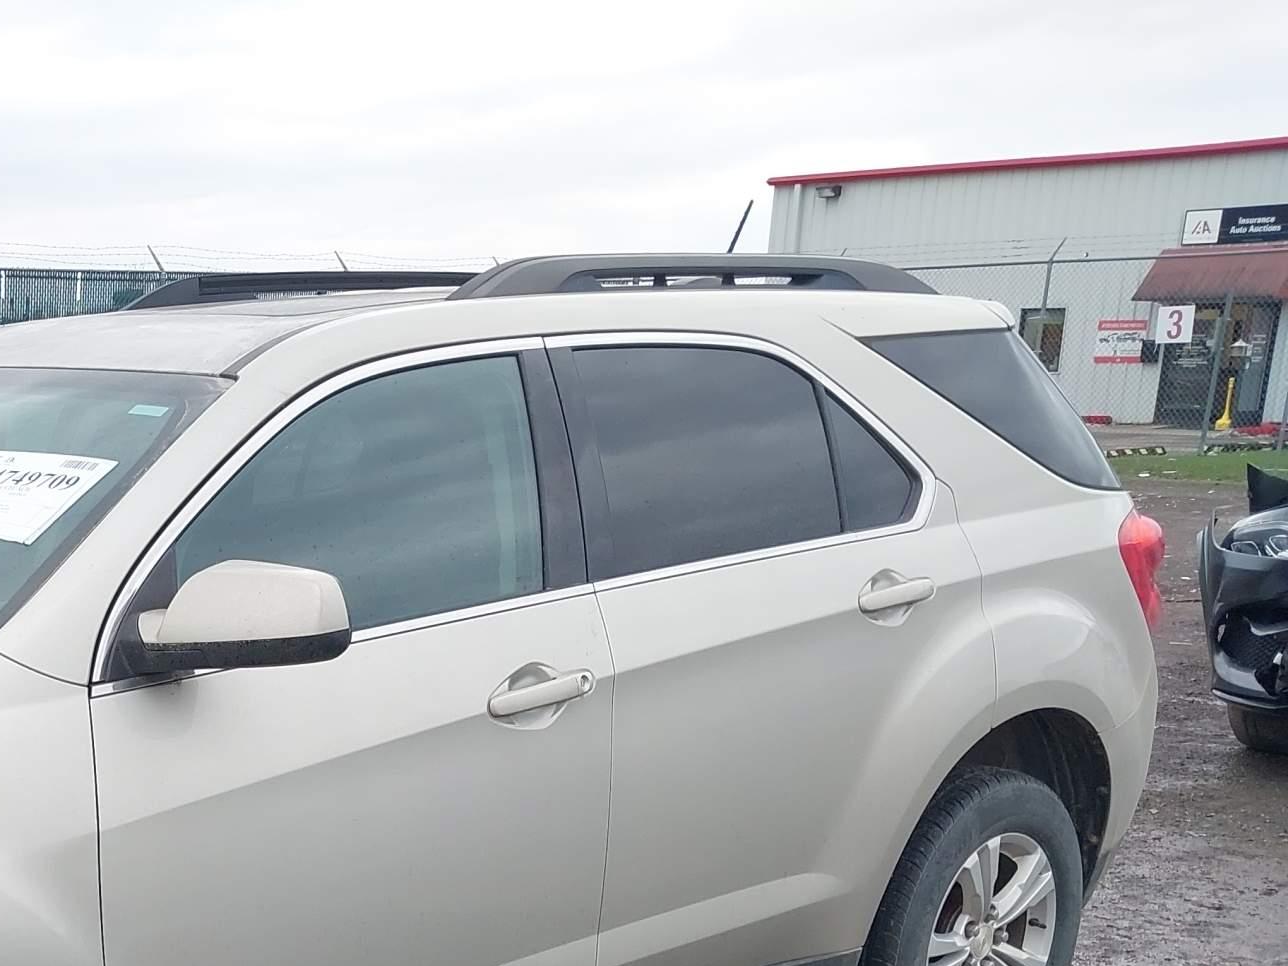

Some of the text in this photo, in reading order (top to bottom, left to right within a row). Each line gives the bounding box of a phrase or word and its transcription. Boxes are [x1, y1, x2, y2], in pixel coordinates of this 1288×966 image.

[1238, 216, 1276, 225] Insurance
[1229, 224, 1282, 234] Auto Auctions
[1166, 309, 1183, 340] 3
